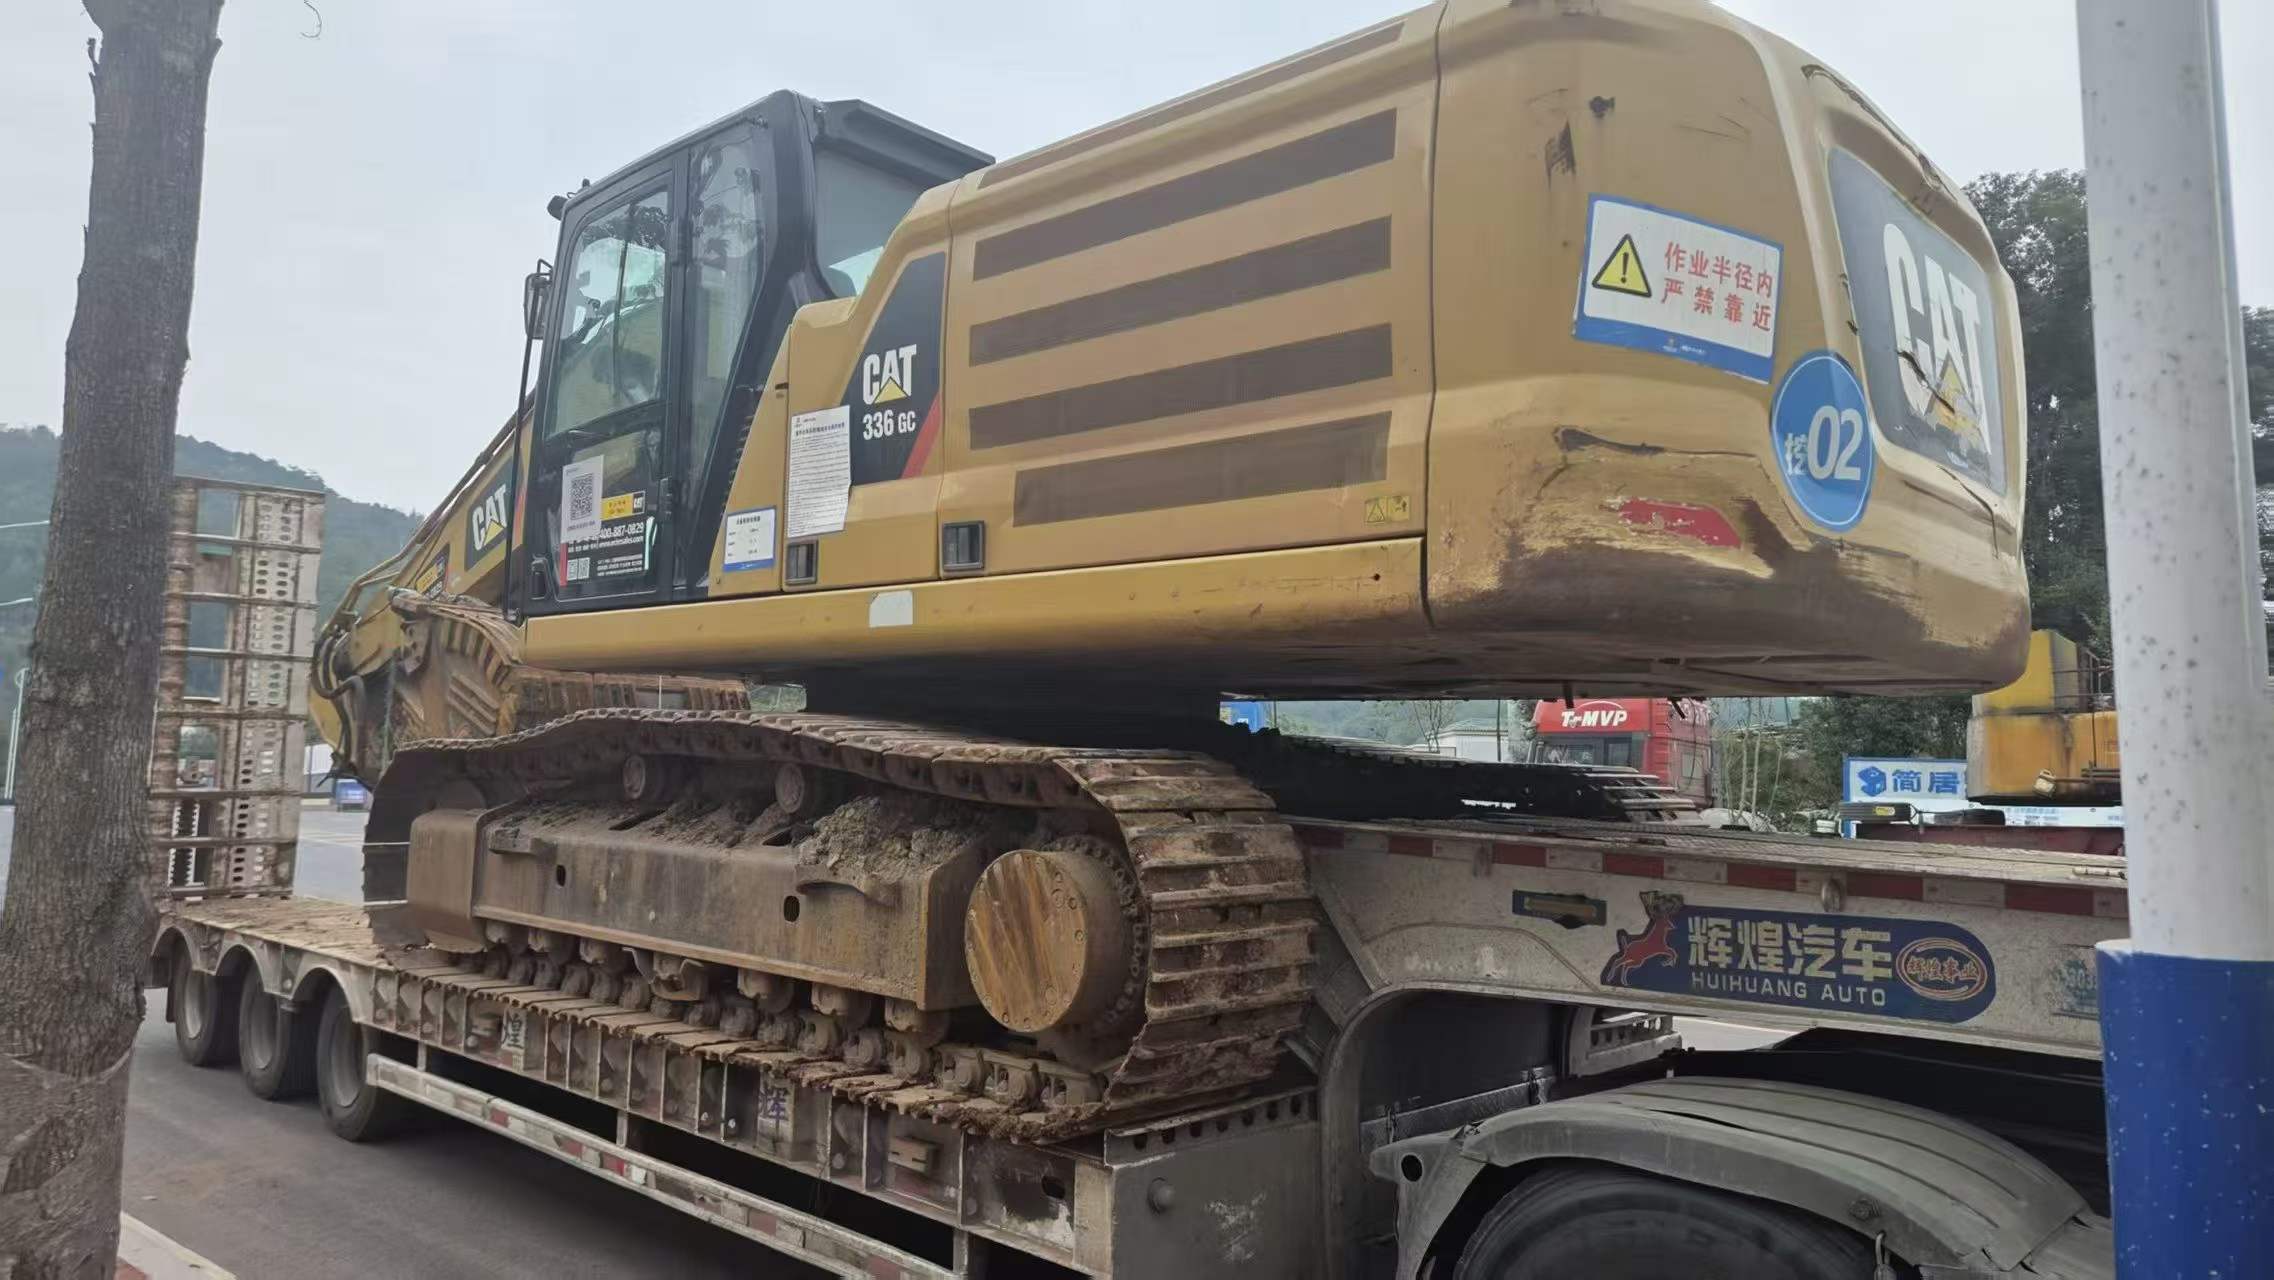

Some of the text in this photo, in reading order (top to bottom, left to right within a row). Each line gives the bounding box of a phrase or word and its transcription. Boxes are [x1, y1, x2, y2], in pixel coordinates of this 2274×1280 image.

[1664, 241, 1773, 299] 作业半径内
[1661, 277, 1772, 332] 严禁靠近
[1884, 224, 1992, 455] CAT
[863, 344, 917, 405] CAT
[863, 410, 894, 441] 336
[898, 411, 916, 434] GC
[472, 484, 507, 551] CAT
[1891, 769, 1960, 795] 简居
[1688, 915, 1893, 983] 辉煌汽车
[1691, 971, 1887, 1006] HUIHUANG AUTO
